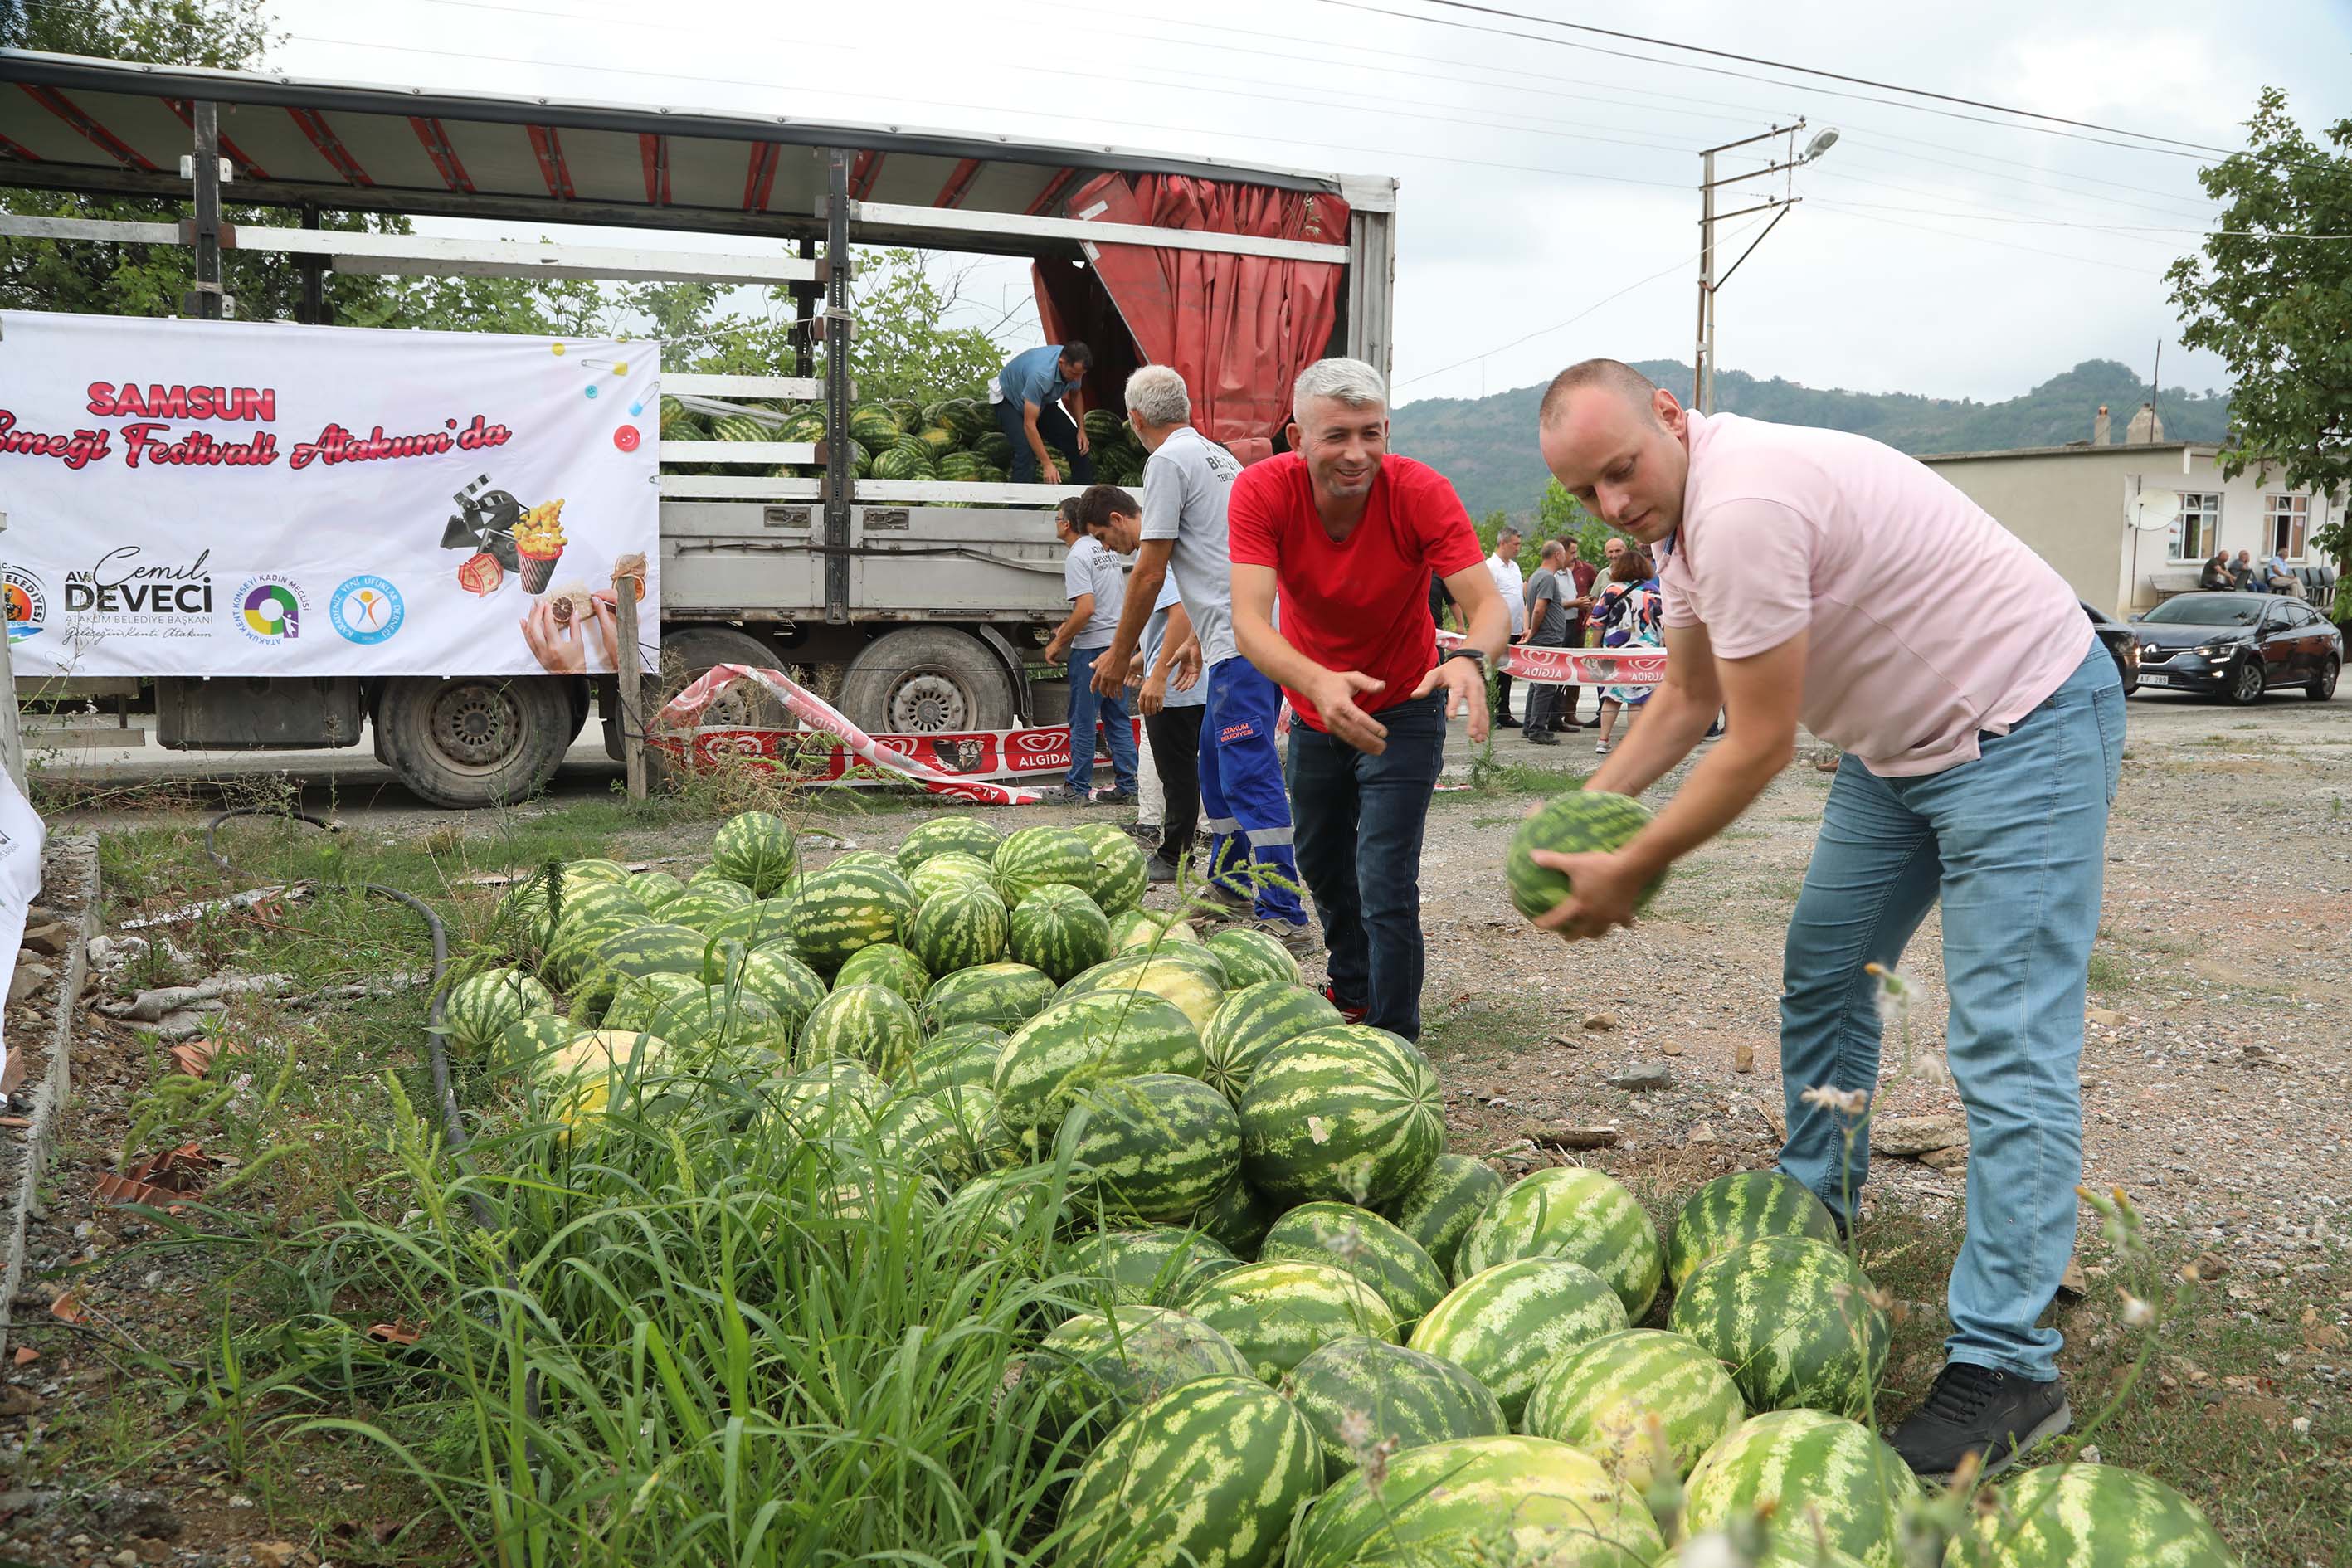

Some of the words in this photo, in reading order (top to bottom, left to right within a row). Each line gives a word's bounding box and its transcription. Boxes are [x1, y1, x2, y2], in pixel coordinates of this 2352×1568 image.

[86, 382, 275, 421] SAMSUN
[120, 422, 280, 468] Festivali
[290, 414, 512, 470] Atakum'da
[93, 546, 209, 587] Cemil
[259, 574, 288, 584] KADIN
[65, 577, 212, 613] DEVECİ
[168, 616, 212, 626] BAŞKANI
[232, 611, 247, 632] KENT
[246, 631, 281, 645] ATAKUM
[1223, 723, 1249, 735] ATAKUM
